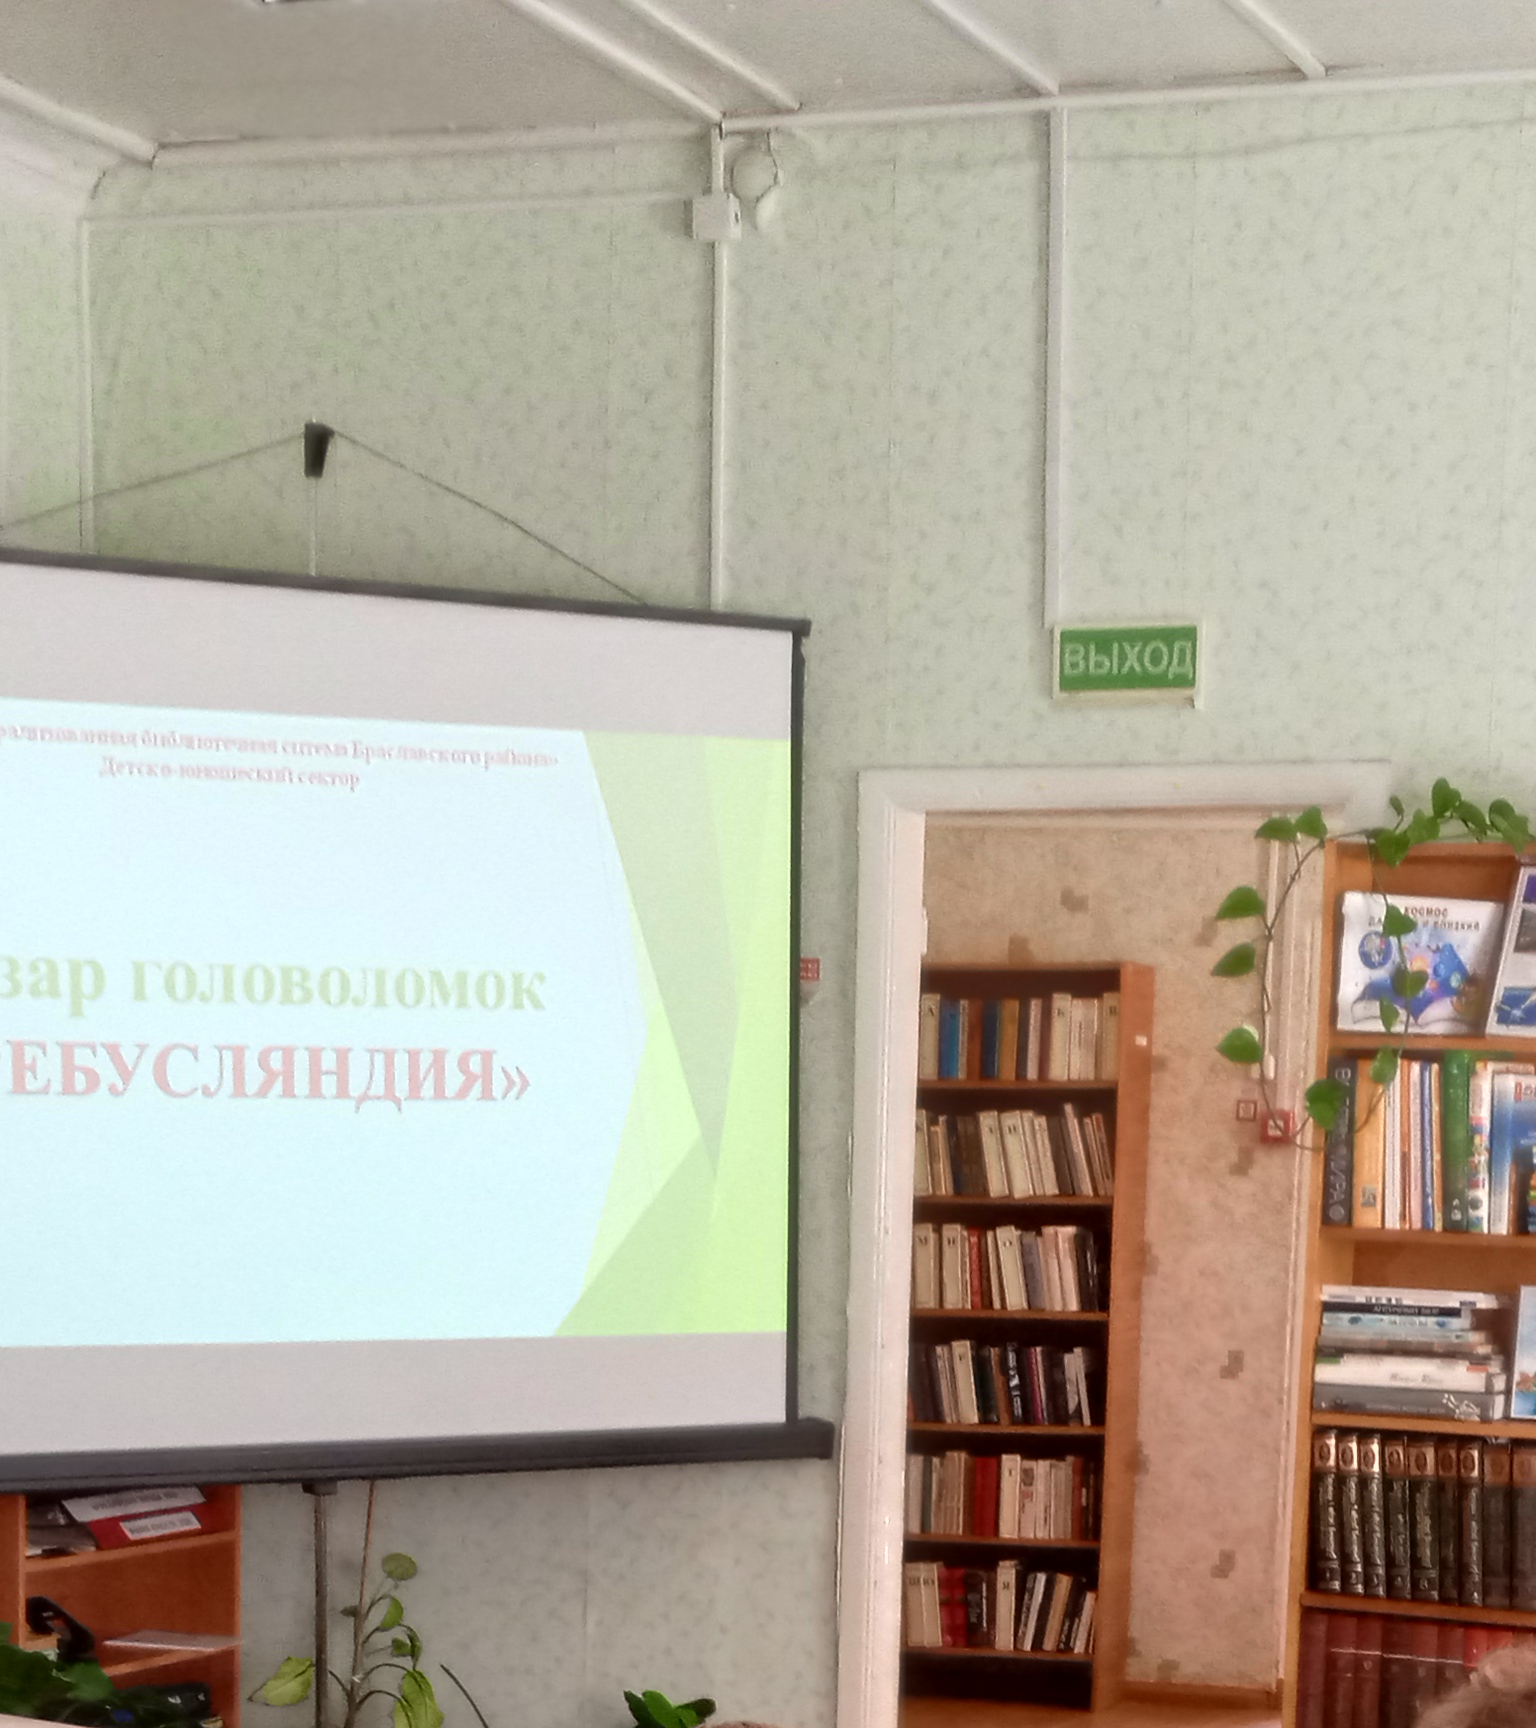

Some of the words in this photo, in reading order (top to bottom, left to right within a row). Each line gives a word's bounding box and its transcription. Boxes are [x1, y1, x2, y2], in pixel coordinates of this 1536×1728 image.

[1062, 638, 1195, 681] ВЫХОД
[297, 770, 360, 793] сектор
[131, 958, 547, 1012] головоломок
